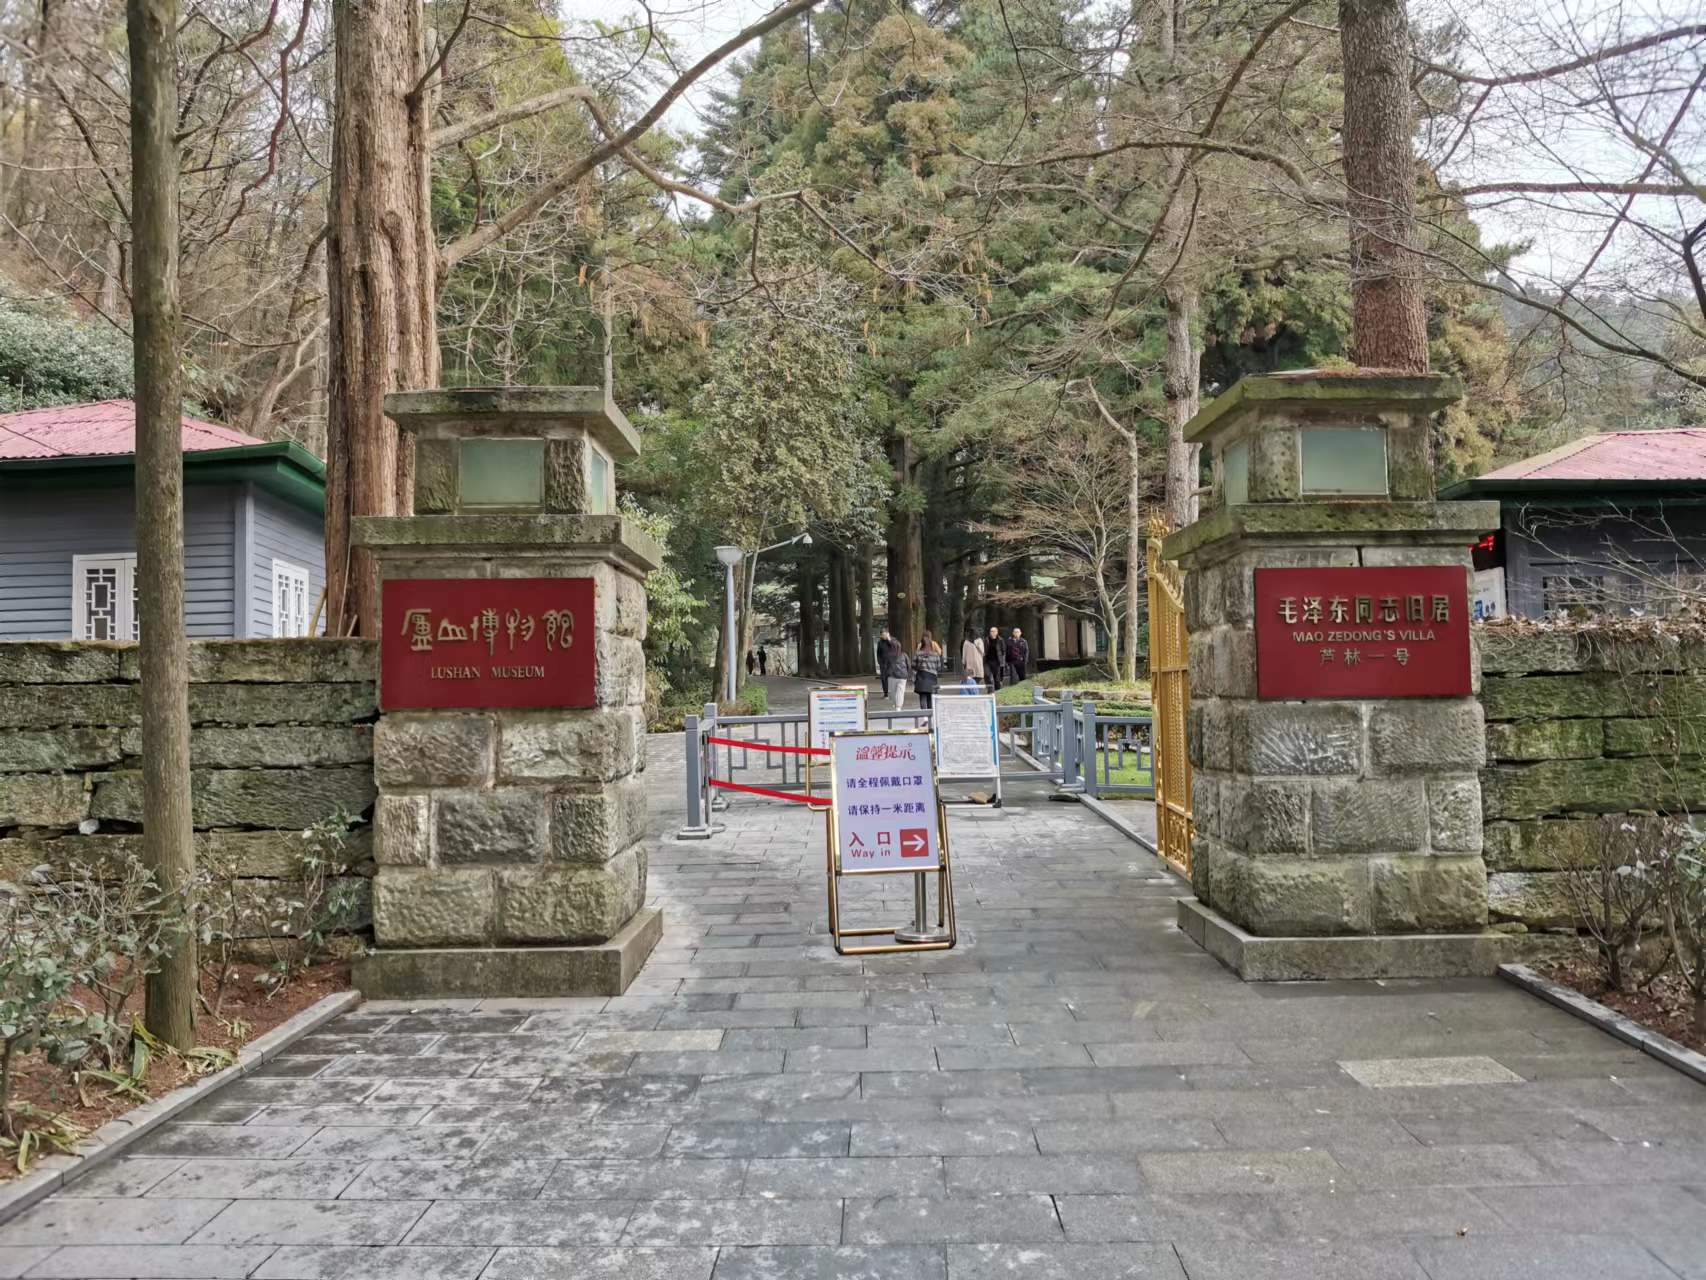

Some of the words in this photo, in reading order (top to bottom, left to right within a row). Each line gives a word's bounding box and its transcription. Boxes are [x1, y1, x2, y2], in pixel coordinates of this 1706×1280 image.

[1278, 595, 1450, 624] 毛泽东同志旧居
[1292, 632, 1324, 642] MAO
[1399, 631, 1436, 641] VILLA
[1319, 648, 1411, 665] 芦林一号
[431, 666, 480, 679] LUSHAN
[491, 665, 545, 679] MUSEUM
[846, 775, 923, 789] 请全程佩戴口罩
[848, 802, 926, 816] 请保持一米距离
[848, 831, 891, 847] 入口
[851, 849, 875, 858] Way
[881, 848, 891, 856] in
